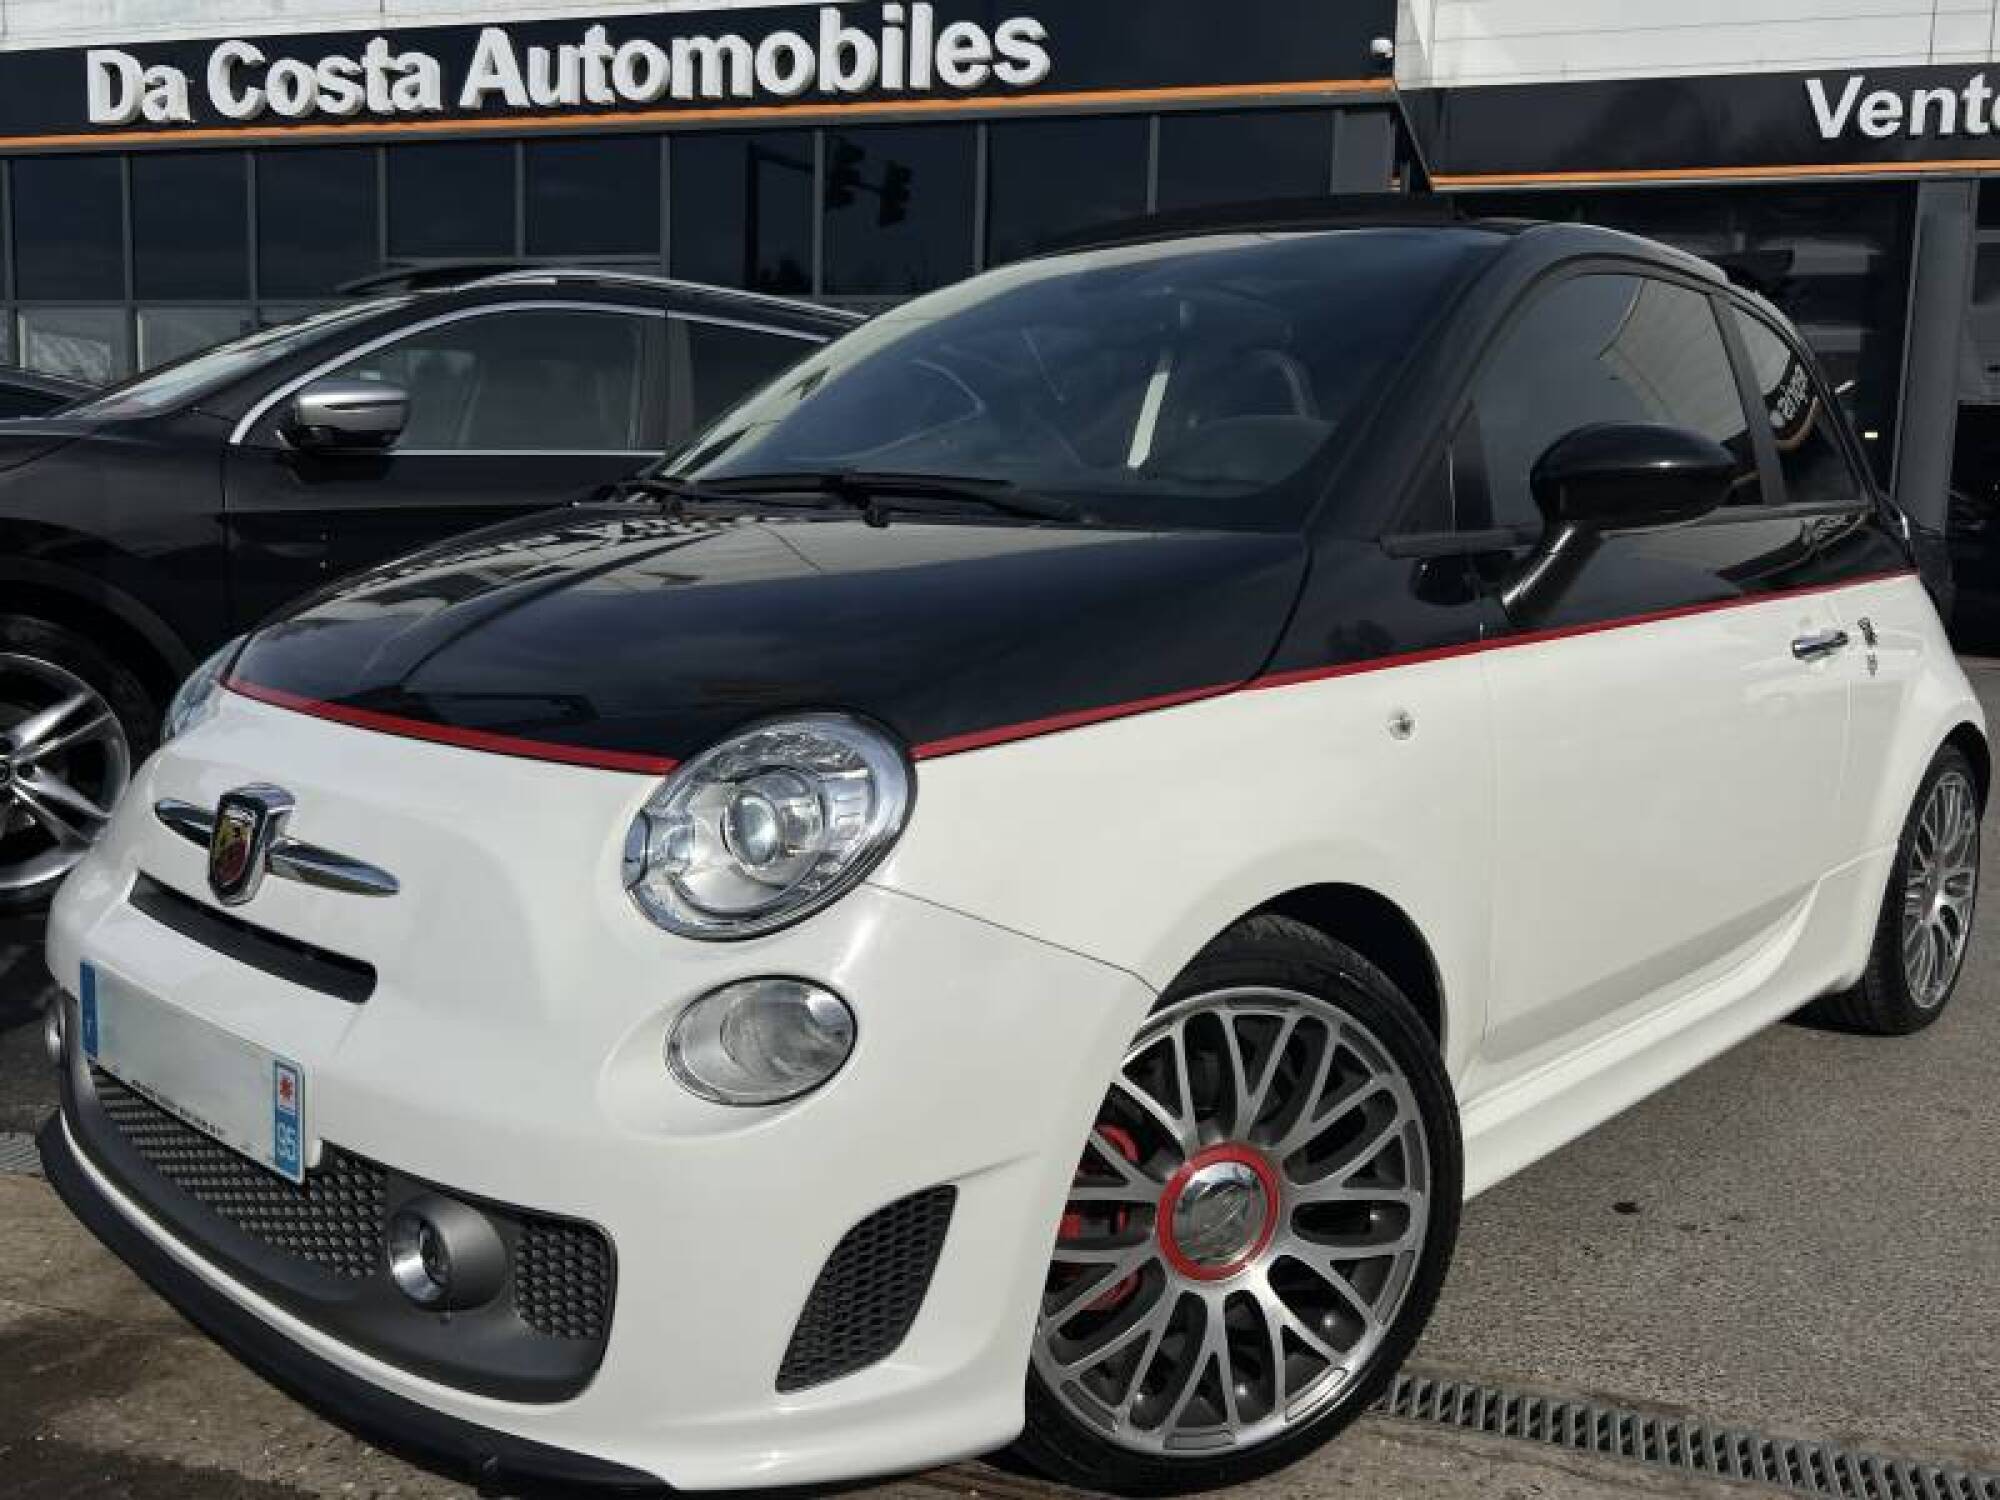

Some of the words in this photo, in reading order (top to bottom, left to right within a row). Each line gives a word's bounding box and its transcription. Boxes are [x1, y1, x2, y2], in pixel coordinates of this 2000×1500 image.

[87, 49, 192, 123] Da
[207, 36, 443, 120] Costa
[459, 2, 1051, 109] Automobiles
[1804, 73, 2000, 139] Vent
